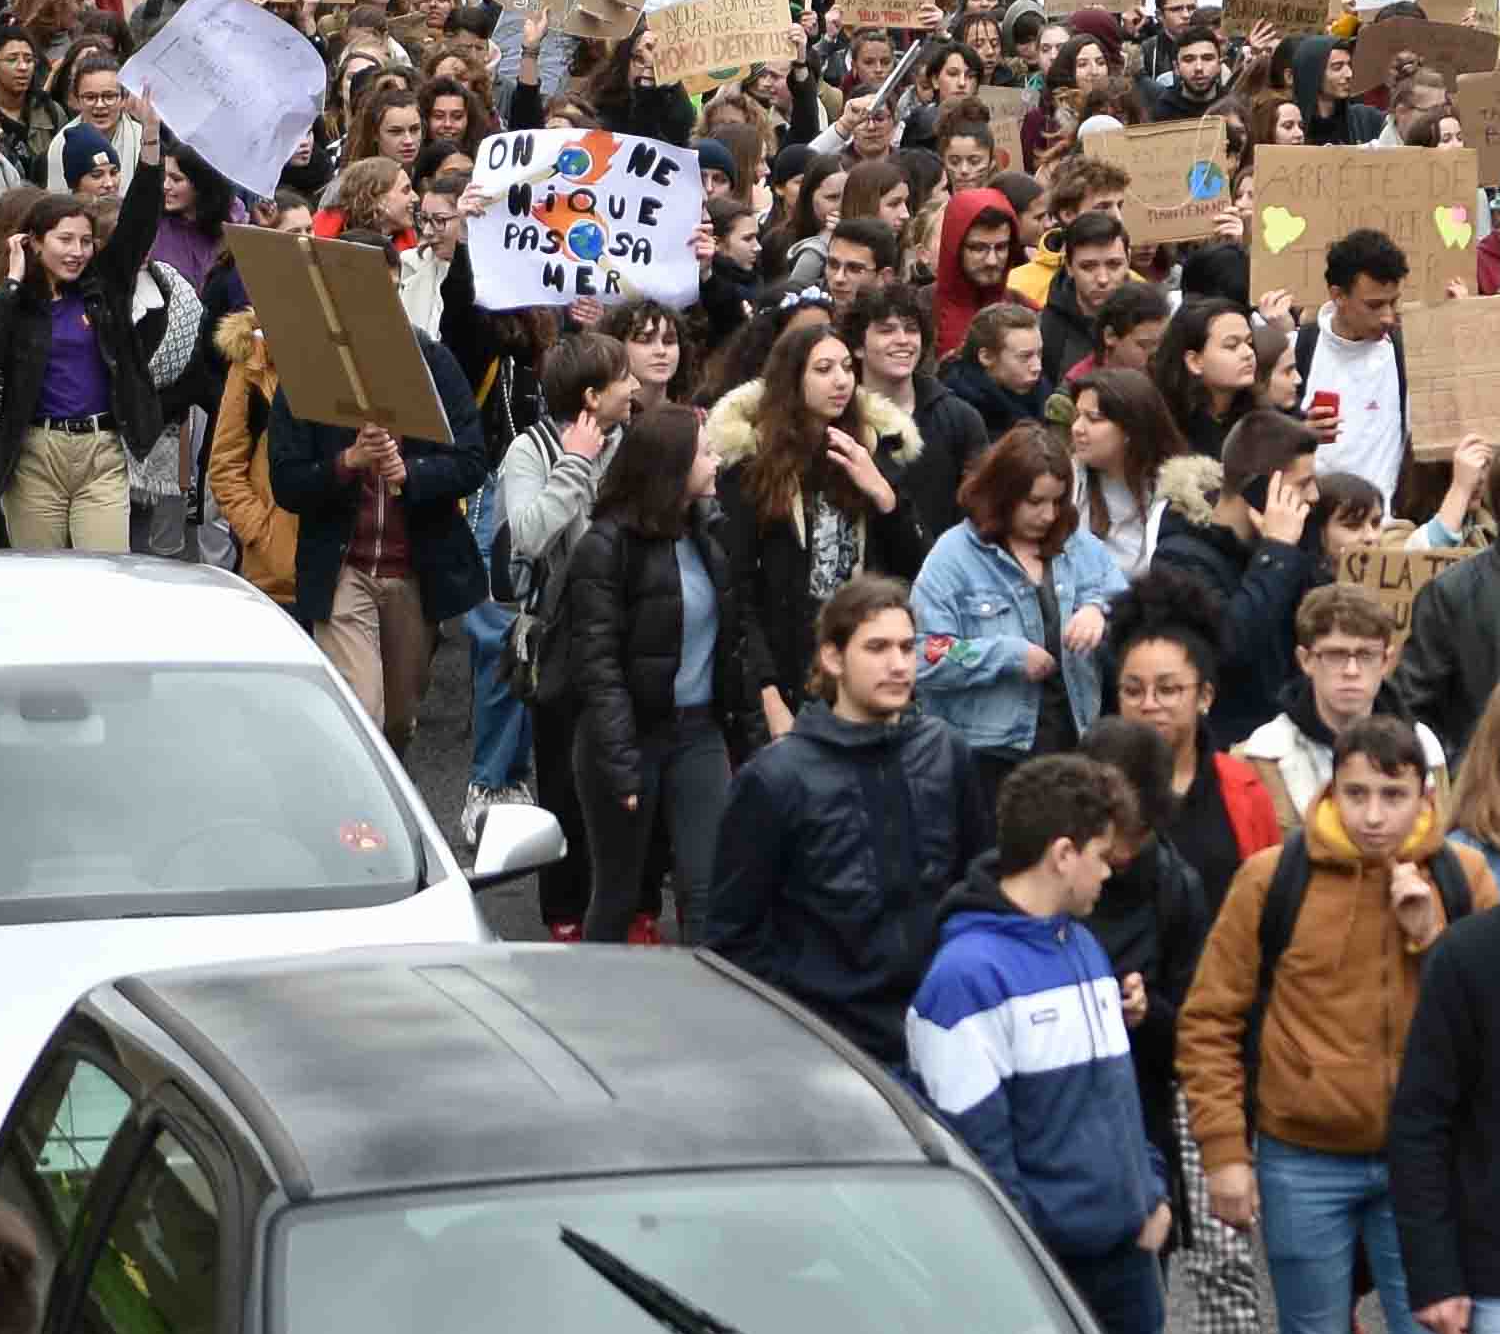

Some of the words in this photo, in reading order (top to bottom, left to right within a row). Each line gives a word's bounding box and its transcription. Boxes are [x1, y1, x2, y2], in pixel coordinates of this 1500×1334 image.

[490, 134, 534, 168] ON
[627, 142, 681, 186] NE
[505, 223, 561, 255] PAS
[610, 232, 652, 265] SA
[1378, 554, 1413, 590] LA
